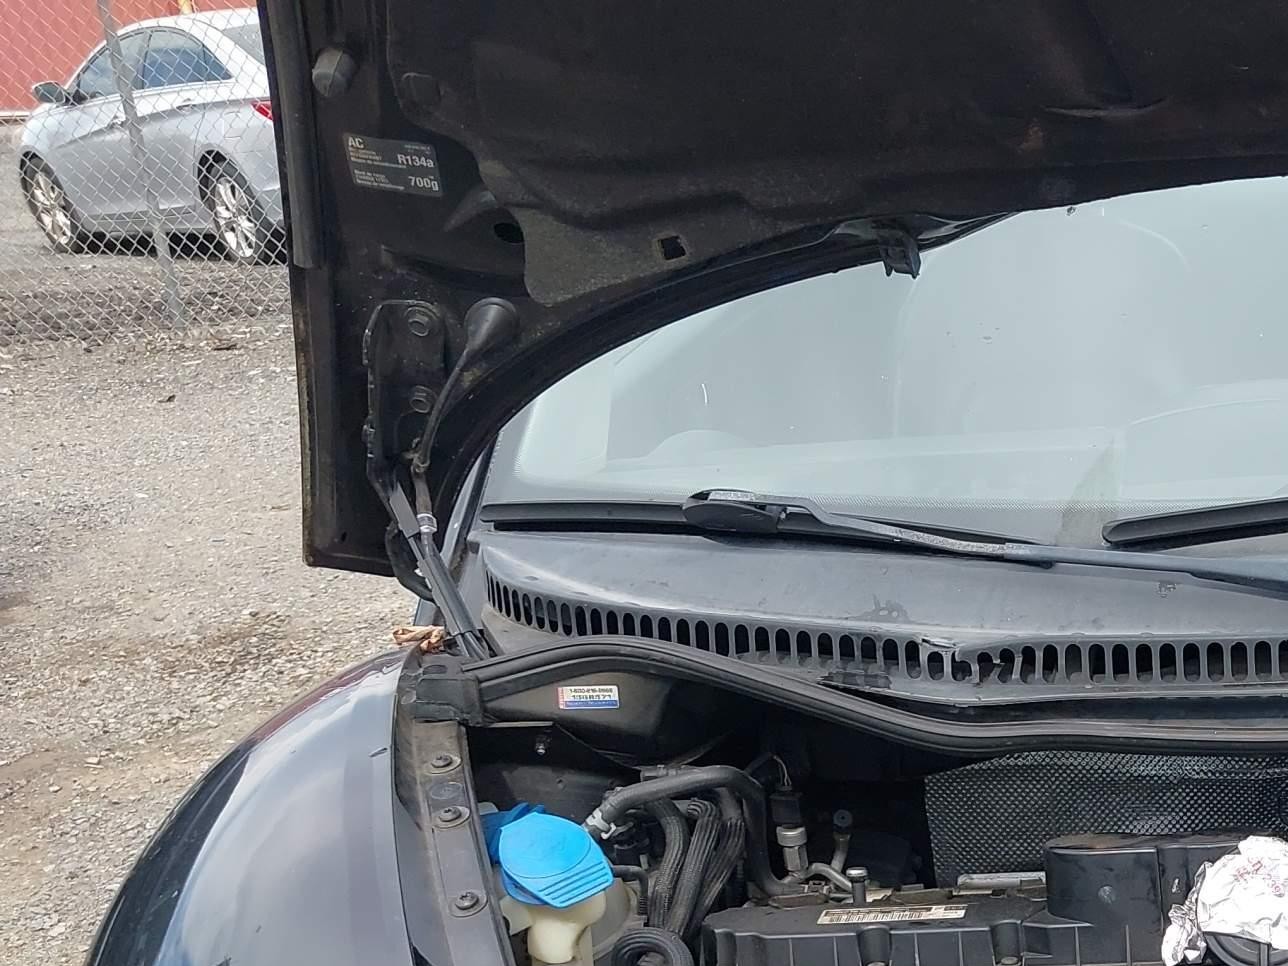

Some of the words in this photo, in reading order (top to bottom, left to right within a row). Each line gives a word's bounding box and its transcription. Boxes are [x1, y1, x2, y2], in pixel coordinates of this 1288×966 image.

[348, 136, 364, 149] AC
[397, 153, 435, 168] R134a
[407, 175, 440, 191] 700g
